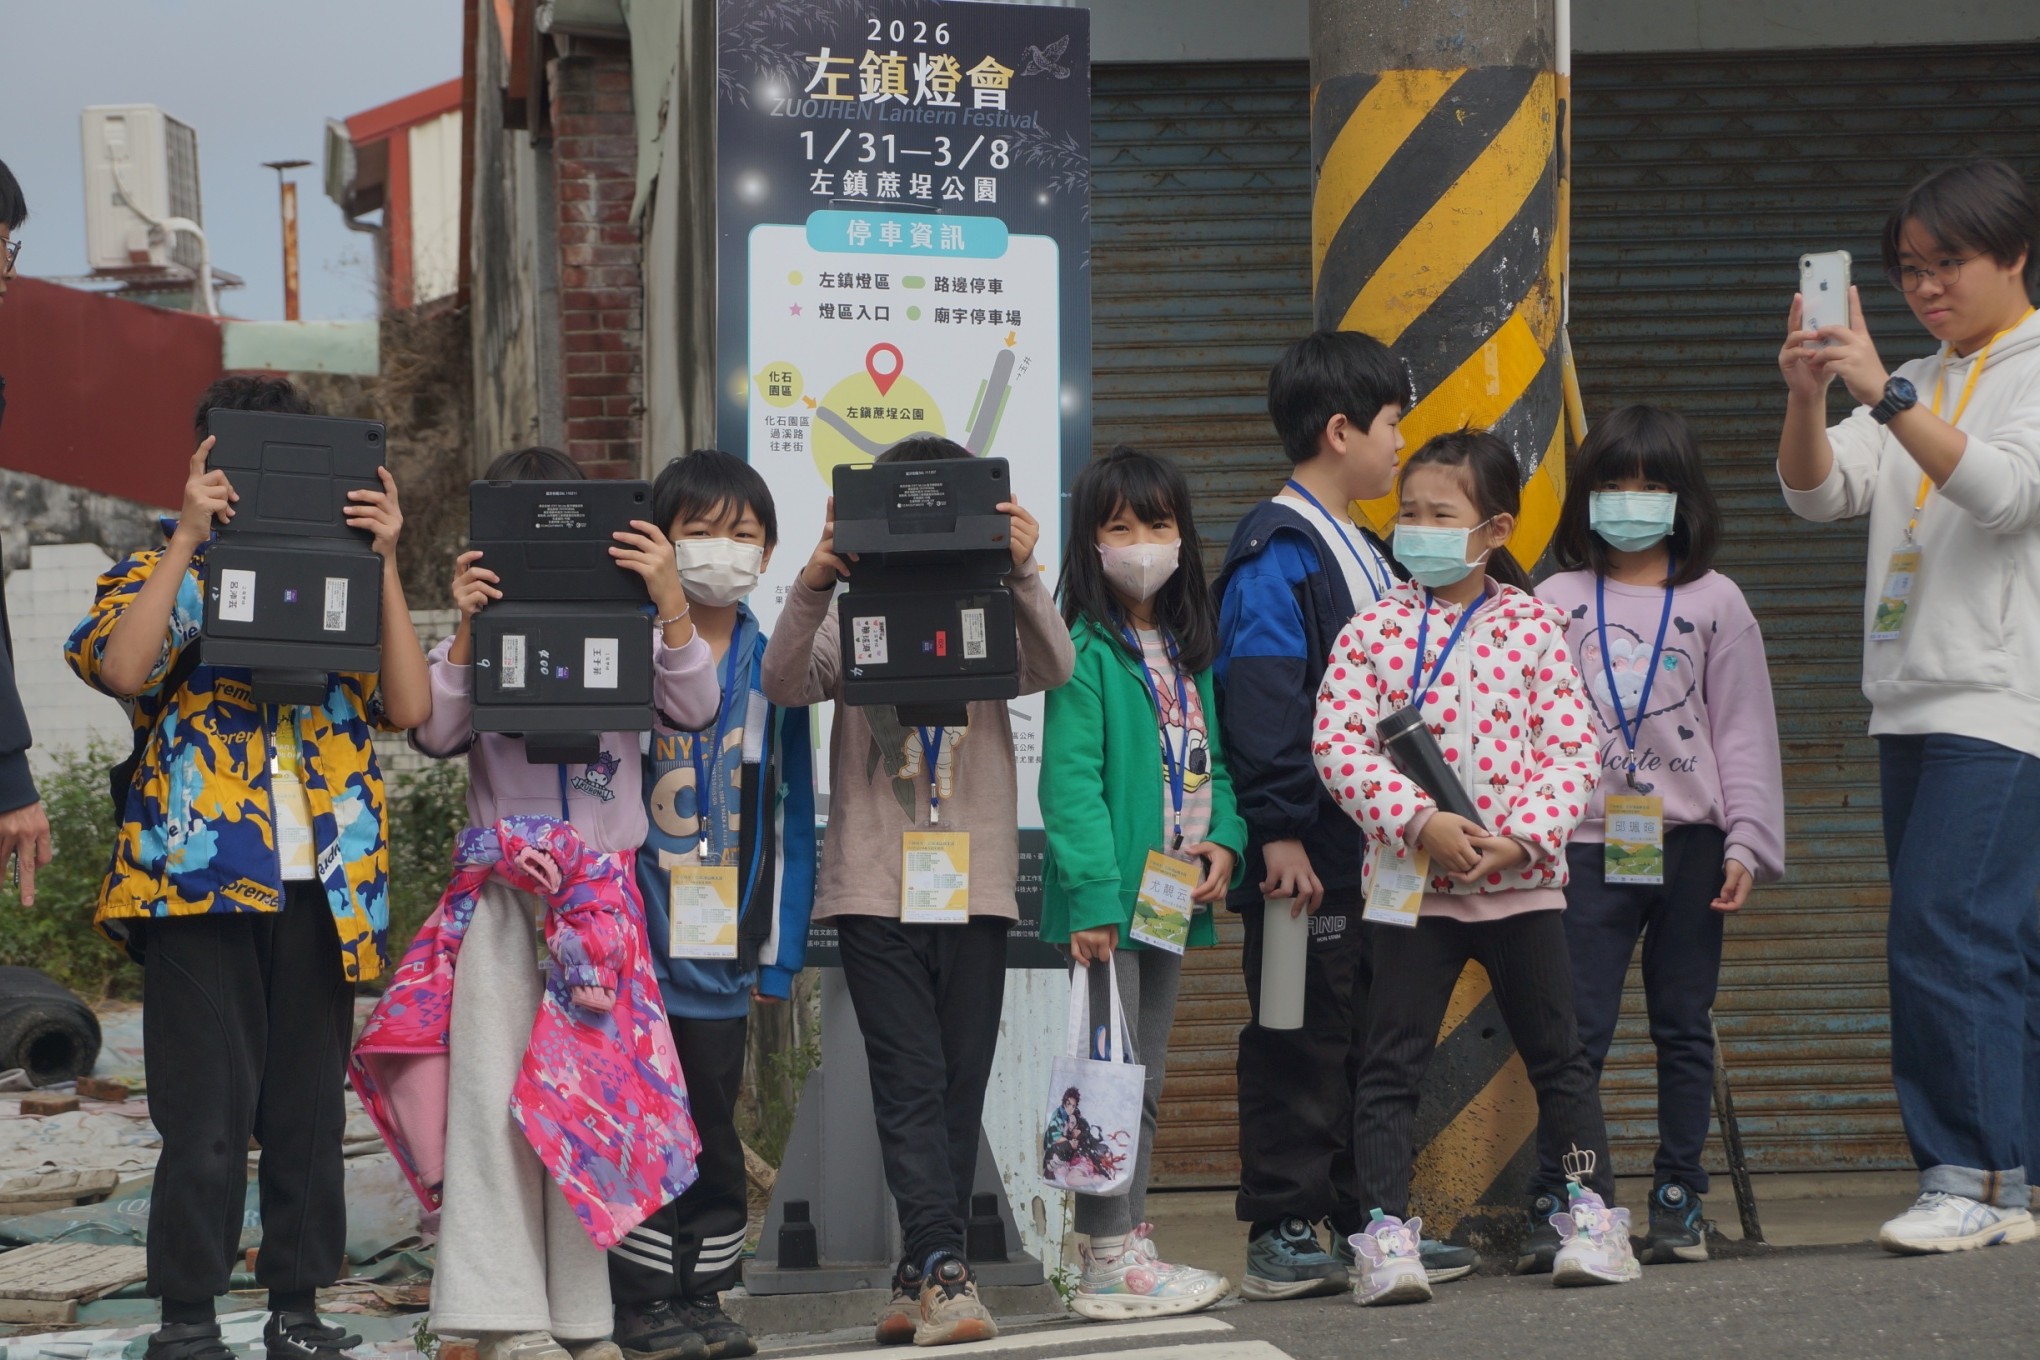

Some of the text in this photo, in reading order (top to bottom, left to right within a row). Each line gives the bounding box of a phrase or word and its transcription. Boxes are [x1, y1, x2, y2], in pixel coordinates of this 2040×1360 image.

[867, 18, 950, 45] 2026
[804, 46, 1015, 111] 左鎮燈會
[770, 98, 1039, 130] ZUOJHEN Lantern Festival
[809, 168, 997, 203] 左鎮蔗埕公園
[846, 219, 965, 251] 停車資訊
[819, 271, 890, 290] 左鎮燈區
[934, 276, 1003, 294] 路邊停車
[819, 303, 890, 321] 燈區入口
[934, 307, 1022, 326] 廟宇停車場
[769, 371, 792, 383] 化石
[769, 385, 792, 397] 園區
[765, 415, 810, 427] 化石園區
[846, 406, 924, 421] 左鎮蔗埕公園
[770, 428, 804, 440] 過溪路
[770, 441, 804, 452] 往老街
